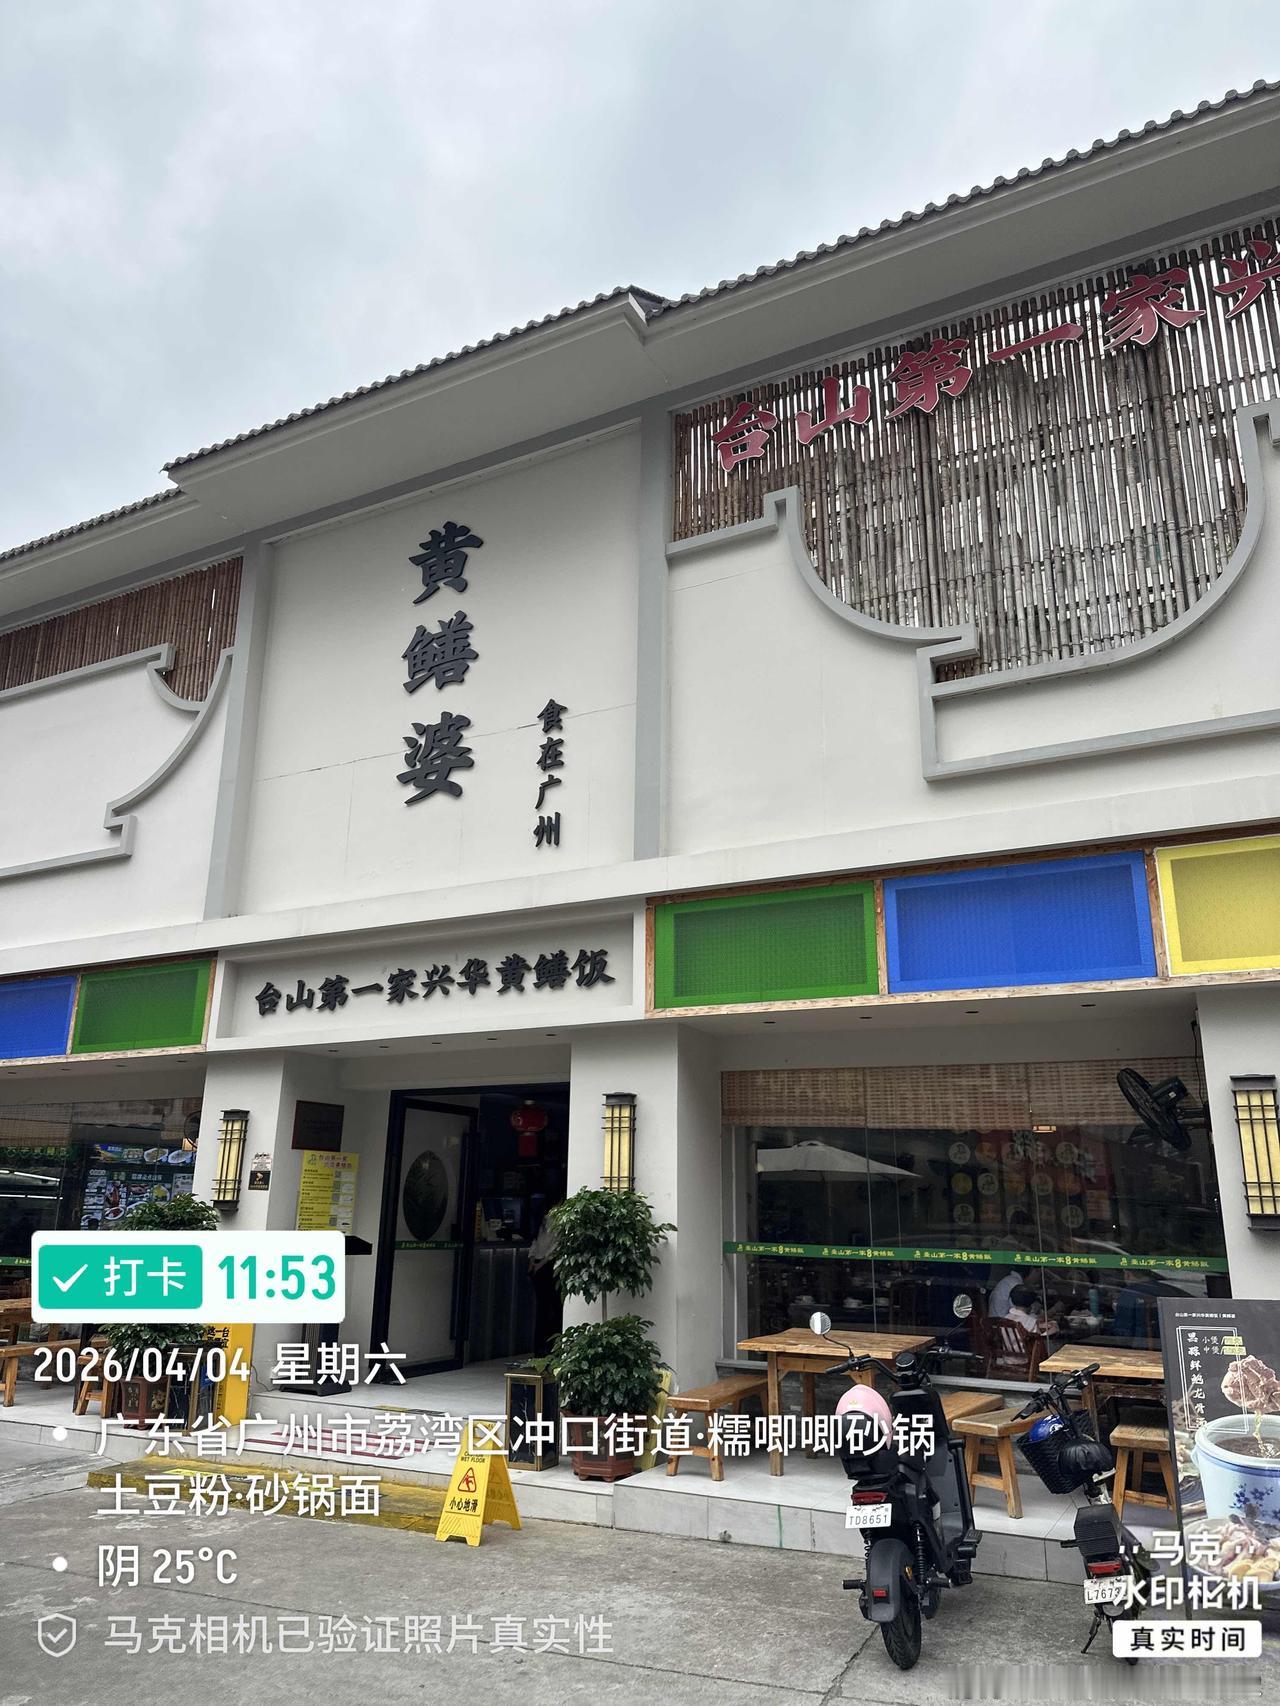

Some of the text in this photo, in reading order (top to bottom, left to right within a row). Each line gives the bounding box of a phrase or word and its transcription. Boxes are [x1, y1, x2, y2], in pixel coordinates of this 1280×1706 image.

[396, 521, 484, 806] 黄鳝婆
[533, 699, 568, 848] 食在广州
[254, 949, 615, 1016] 台山第一家兴华黄鳝饭
[449, 1497, 478, 1513] 小心地滑
[849, 1514, 888, 1526] TD8651
